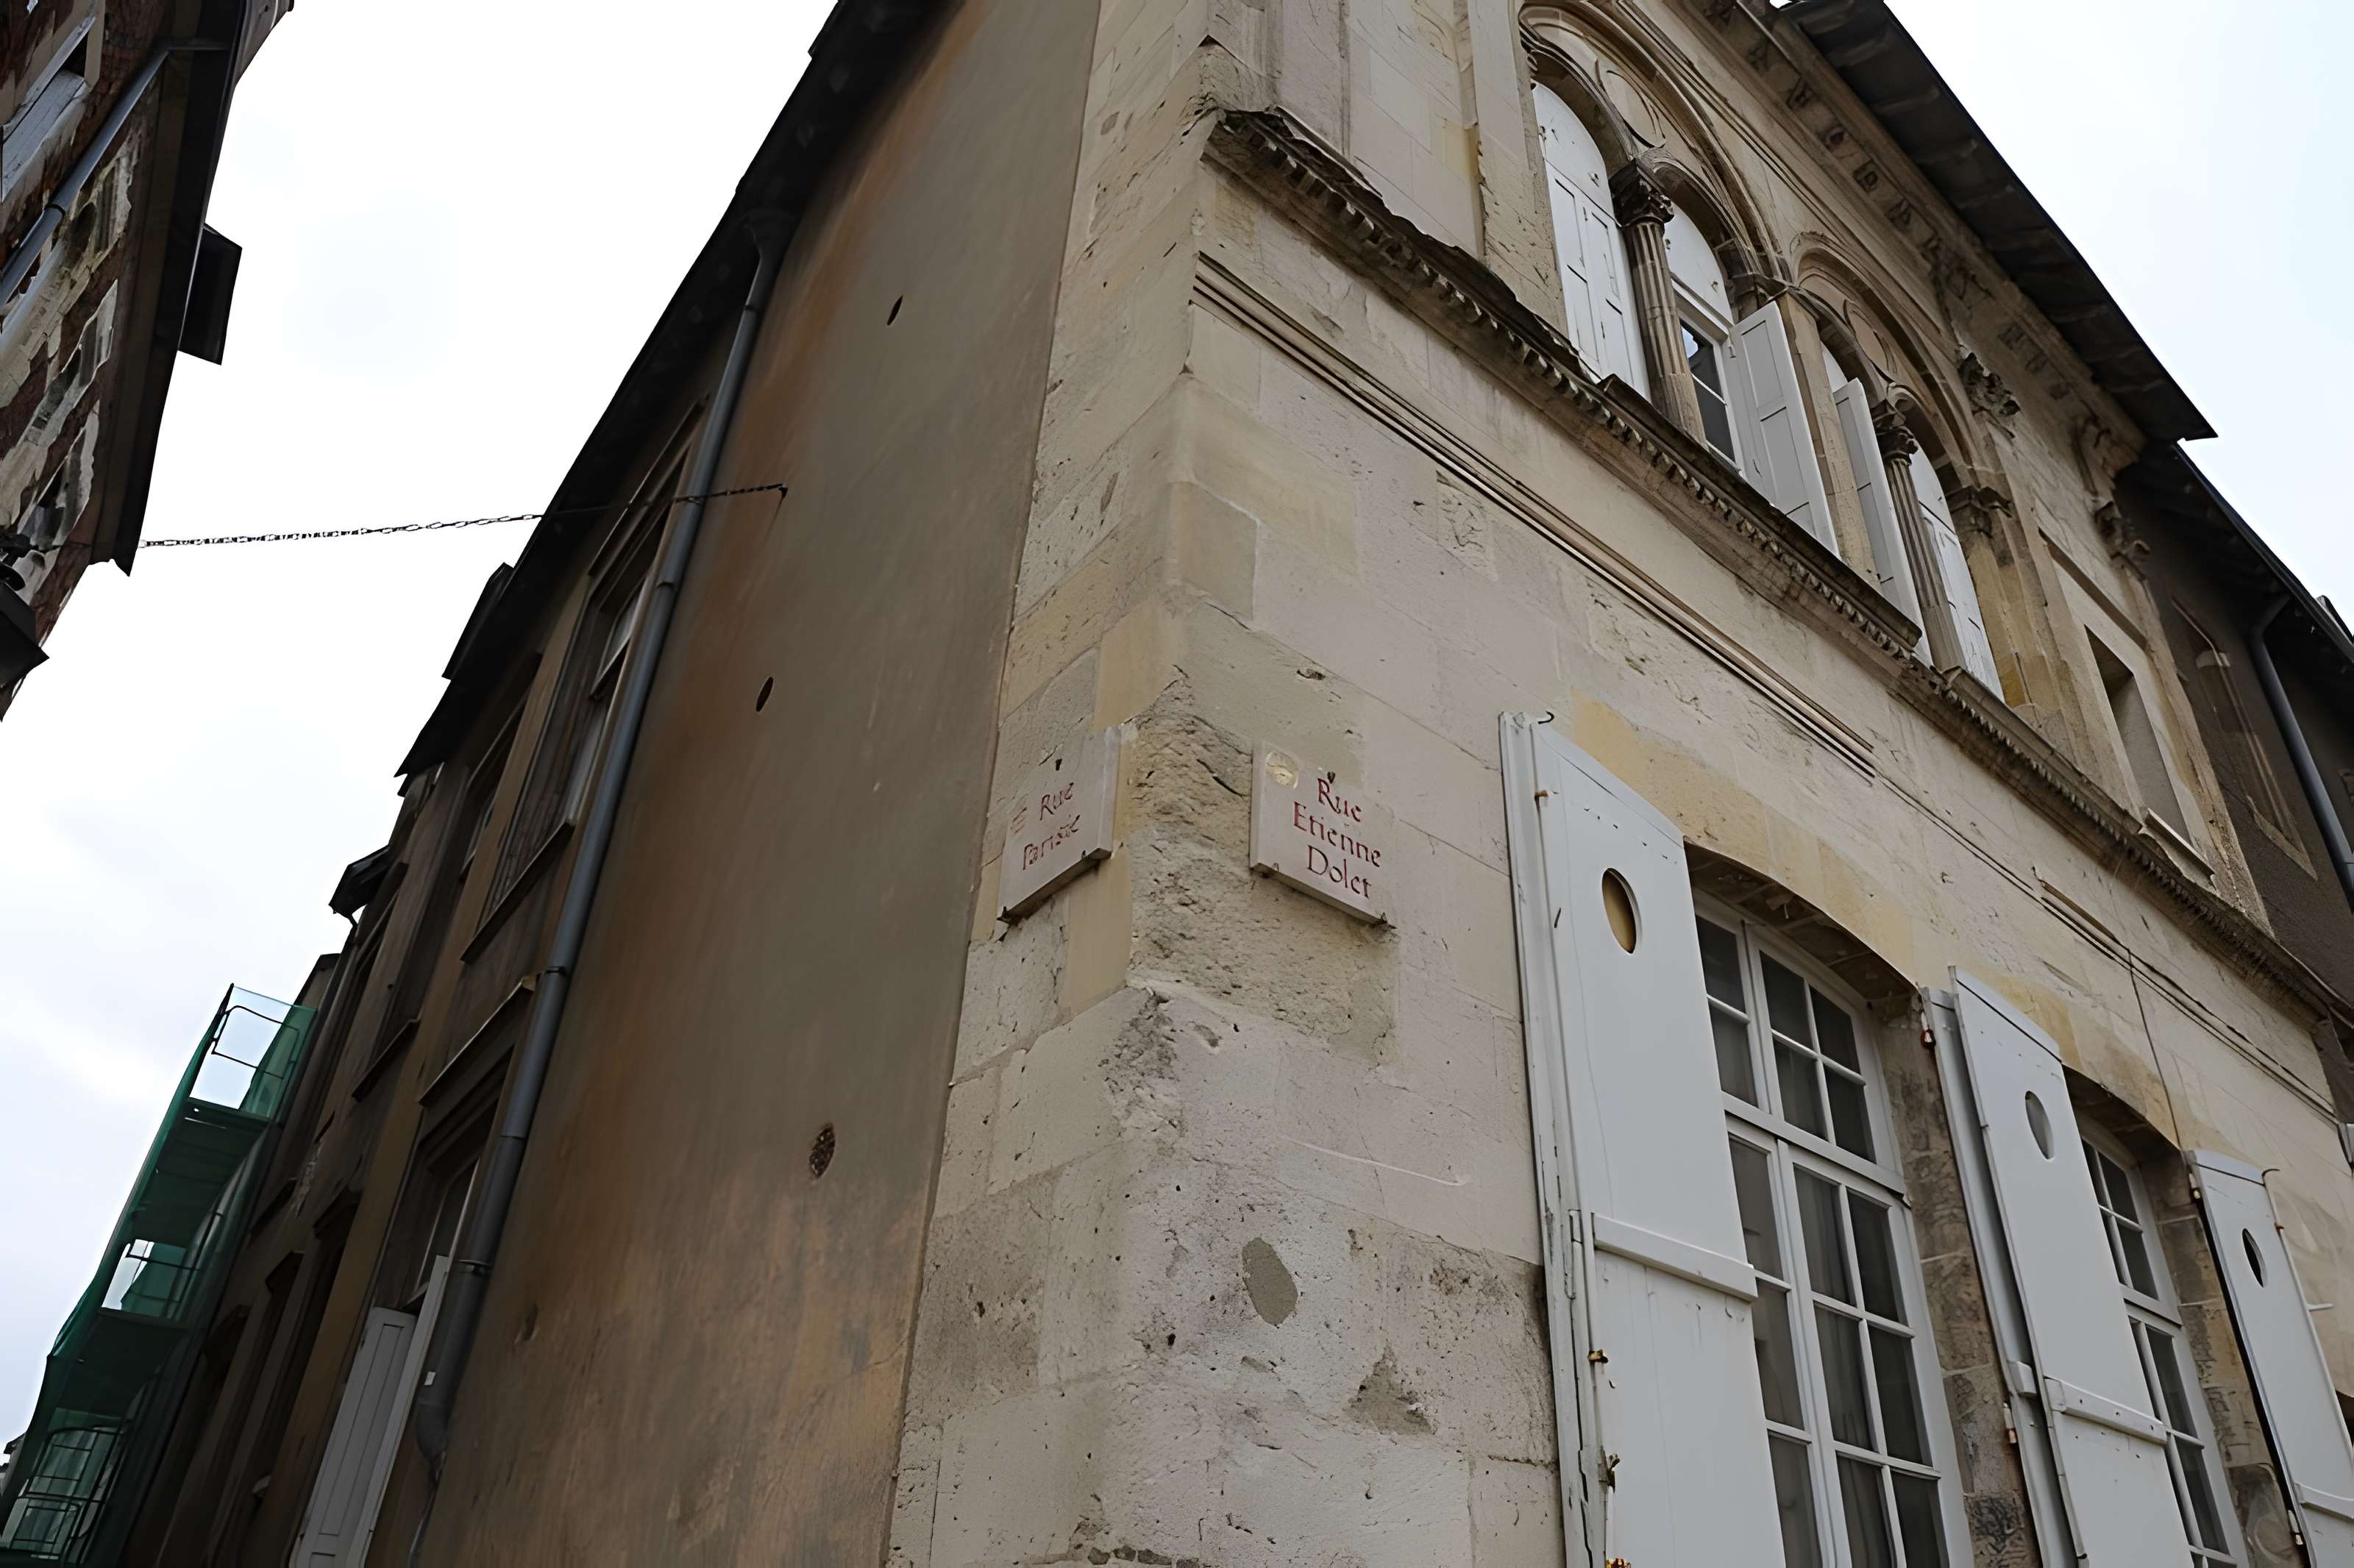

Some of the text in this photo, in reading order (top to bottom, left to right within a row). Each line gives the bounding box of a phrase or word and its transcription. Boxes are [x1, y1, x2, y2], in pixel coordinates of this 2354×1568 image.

[1040, 782, 1074, 821] Rue
[1318, 777, 1362, 822] Rue
[1294, 801, 1381, 868] Etienne
[1306, 844, 1372, 899] Dolet
